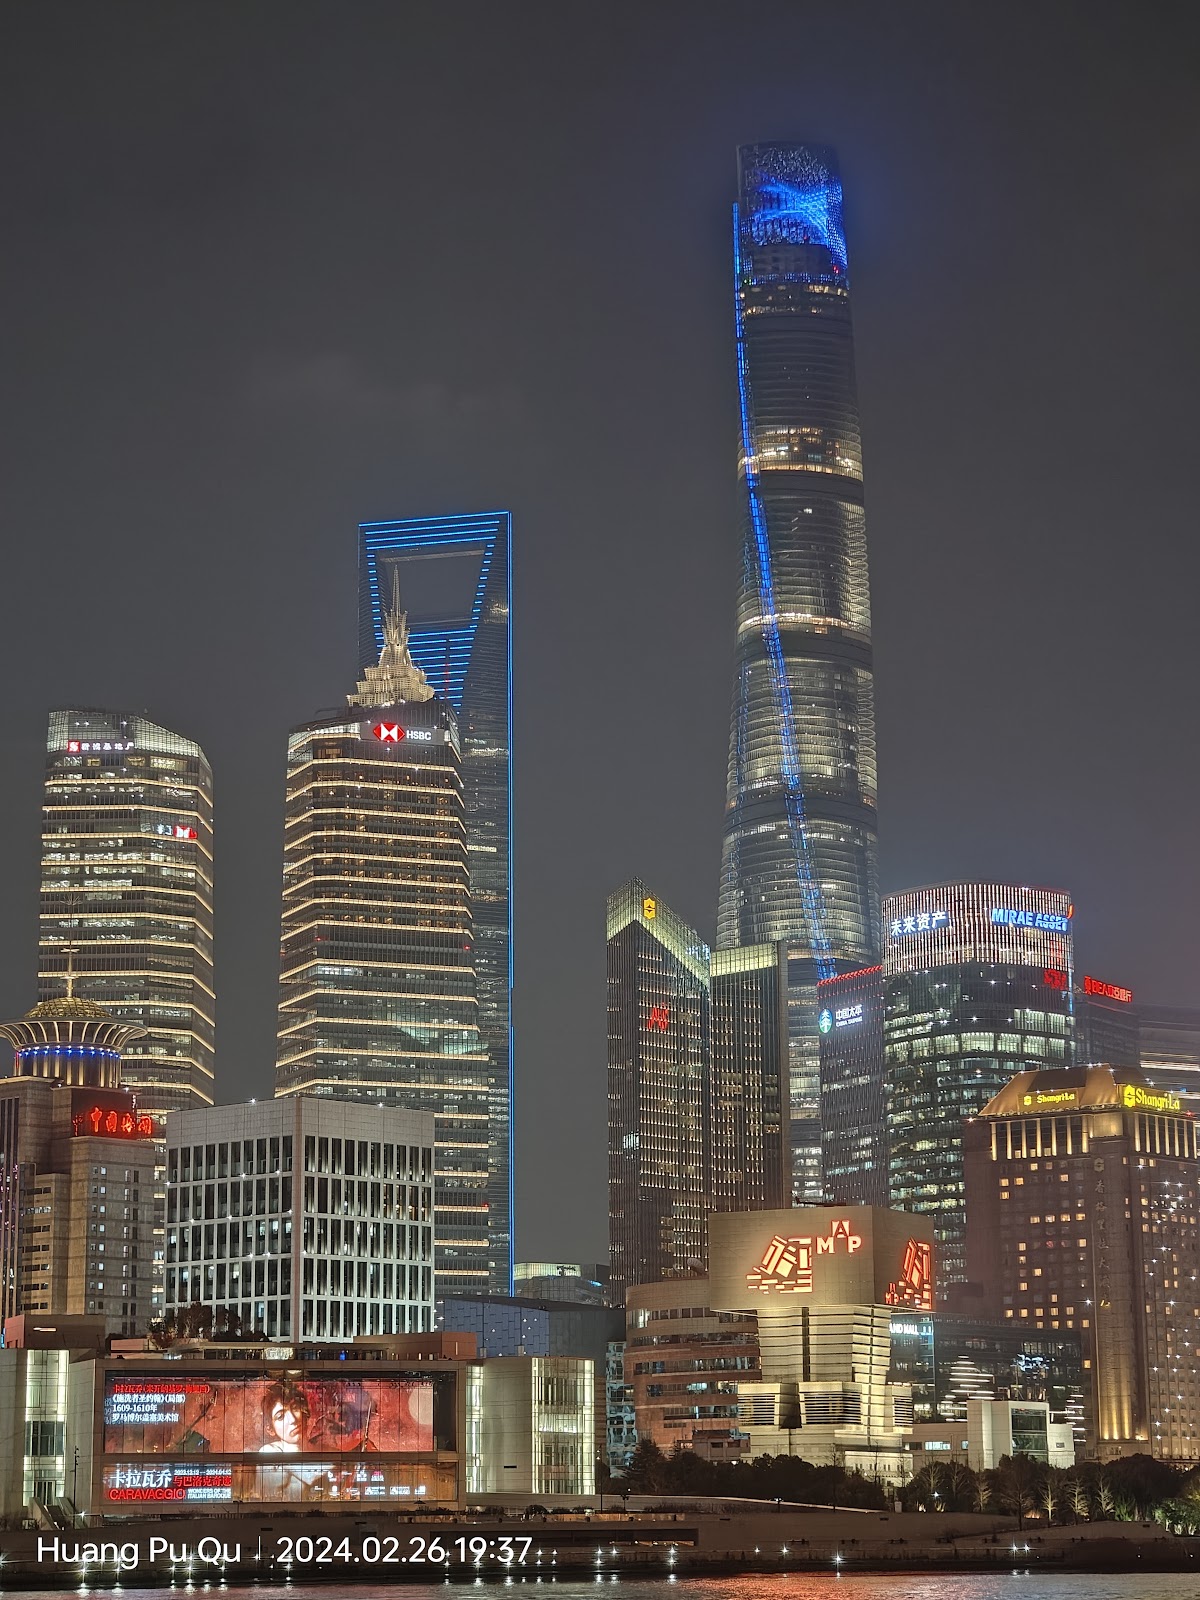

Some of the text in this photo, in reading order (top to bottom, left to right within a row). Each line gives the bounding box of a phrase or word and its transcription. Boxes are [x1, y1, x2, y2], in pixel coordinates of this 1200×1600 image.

[406, 729, 432, 741] HSBC
[890, 910, 947, 937] 未来资产
[991, 907, 1068, 932] MIRAE ASSET
[816, 1220, 862, 1254] MAP
[113, 1403, 158, 1412] 1609-1610年
[110, 1468, 172, 1488] 卡拉瓦乔
[109, 1488, 186, 1500] CARAVAGGIO
